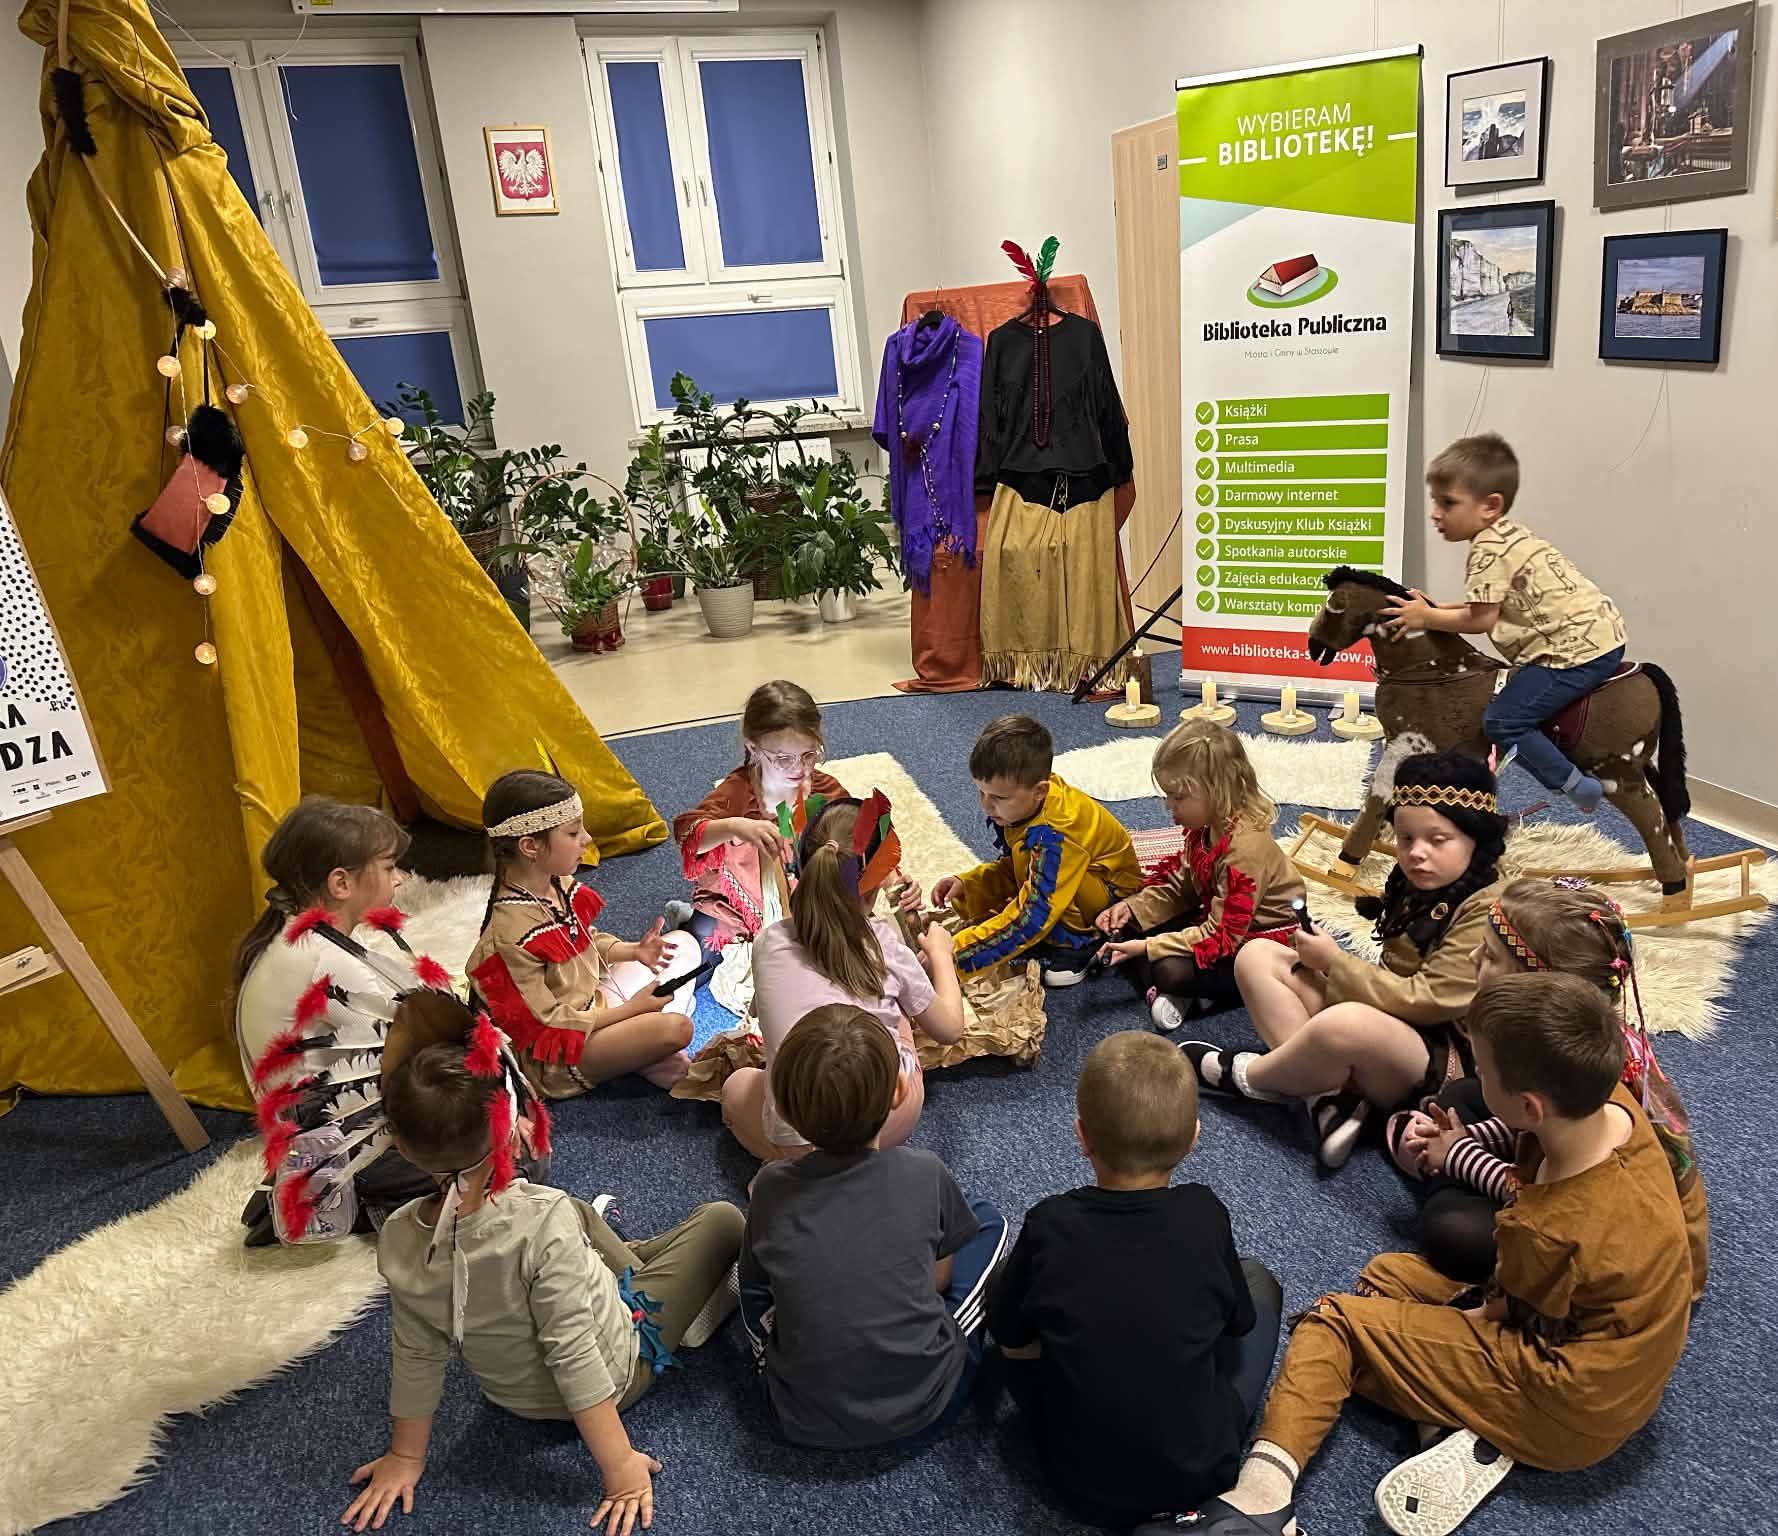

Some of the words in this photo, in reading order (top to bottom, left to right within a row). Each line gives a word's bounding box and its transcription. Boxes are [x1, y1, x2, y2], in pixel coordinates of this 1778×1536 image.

[1236, 102, 1351, 137] WYBIERAM
[1218, 124, 1374, 166] BIBLIOTEKĘ!
[1202, 319, 1292, 342] Biblioteka
[1298, 313, 1387, 336] Publiczna
[1225, 403, 1267, 420] Książki
[1225, 433, 1259, 446] Prasa
[1225, 460, 1295, 474] Multimedia
[1225, 489, 1283, 504] Darmowy
[1287, 488, 1339, 501] internet
[1225, 517, 1293, 534] Dyskusyjny
[1296, 517, 1325, 531] Klub
[1328, 516, 1372, 534] Książki
[1224, 544, 1285, 559] Spotkania
[1287, 546, 1347, 559] autorskie
[1224, 571, 1266, 586] Zajęcia
[1269, 572, 1325, 588] edukacyj
[1224, 597, 1285, 614] Warsztaty
[1287, 600, 1322, 616] komp
